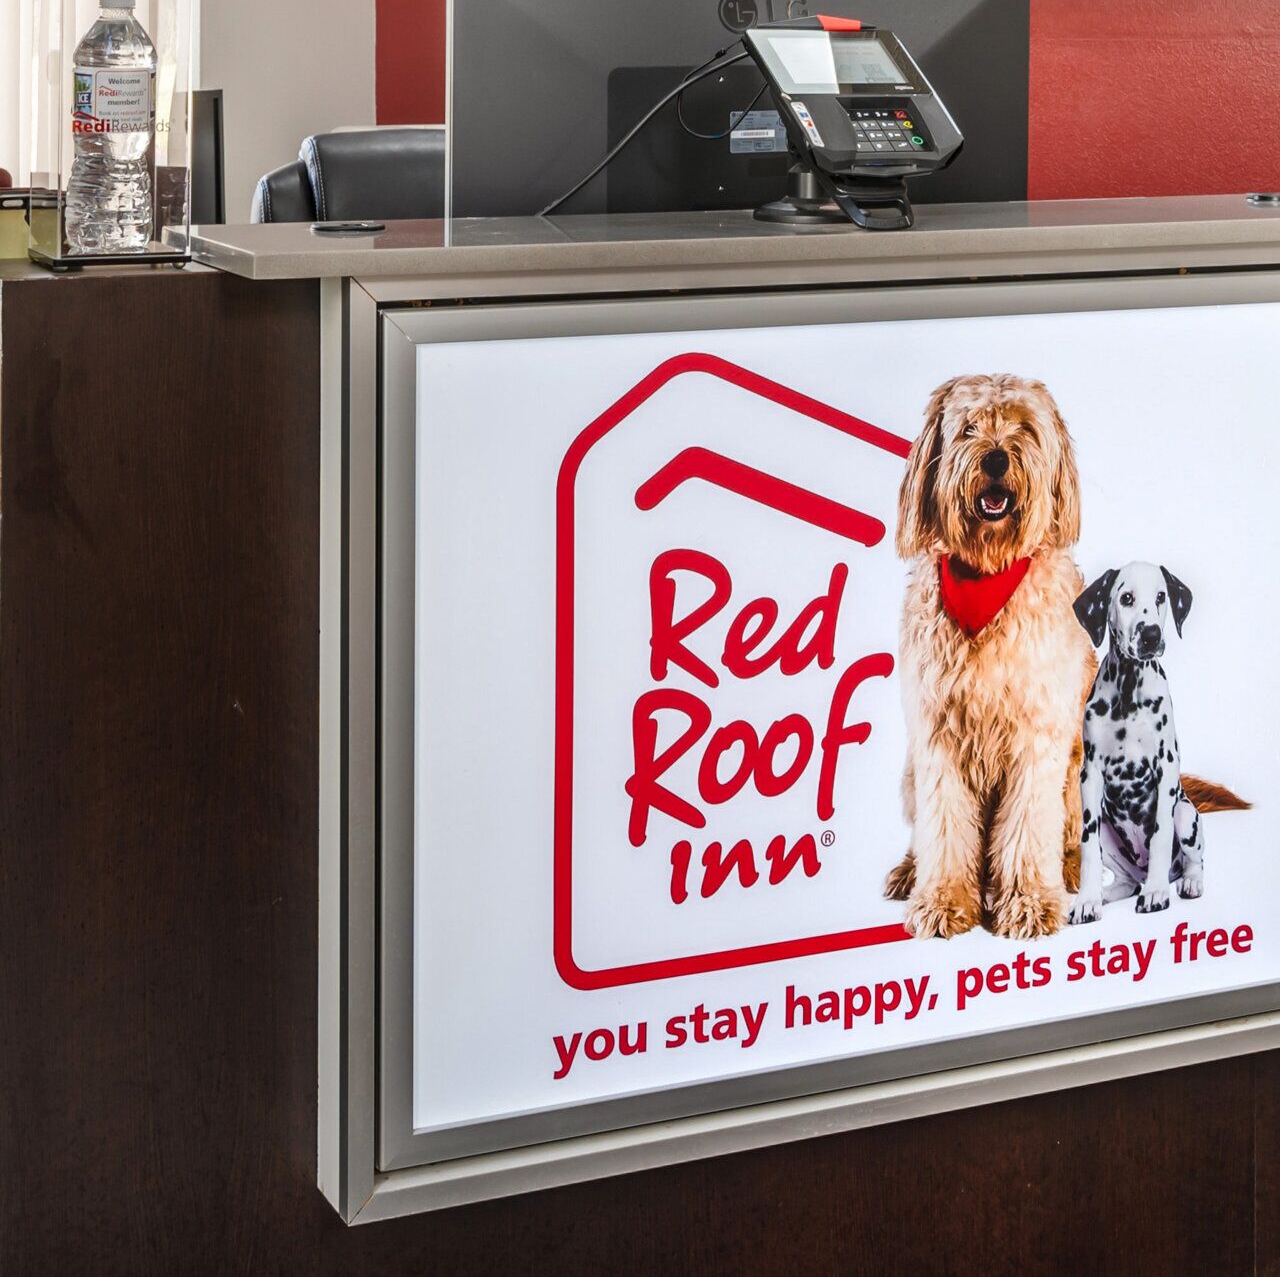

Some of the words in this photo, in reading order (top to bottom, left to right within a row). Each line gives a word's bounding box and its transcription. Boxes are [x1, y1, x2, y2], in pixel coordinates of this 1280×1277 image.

[650, 549, 848, 688] Red
[628, 652, 894, 847] Roof
[552, 1023, 648, 1080] you
[664, 999, 769, 1049] stay
[785, 973, 939, 1029] happy,
[957, 951, 1051, 1010] pets
[1066, 934, 1159, 982] stay
[1170, 923, 1254, 964] free
